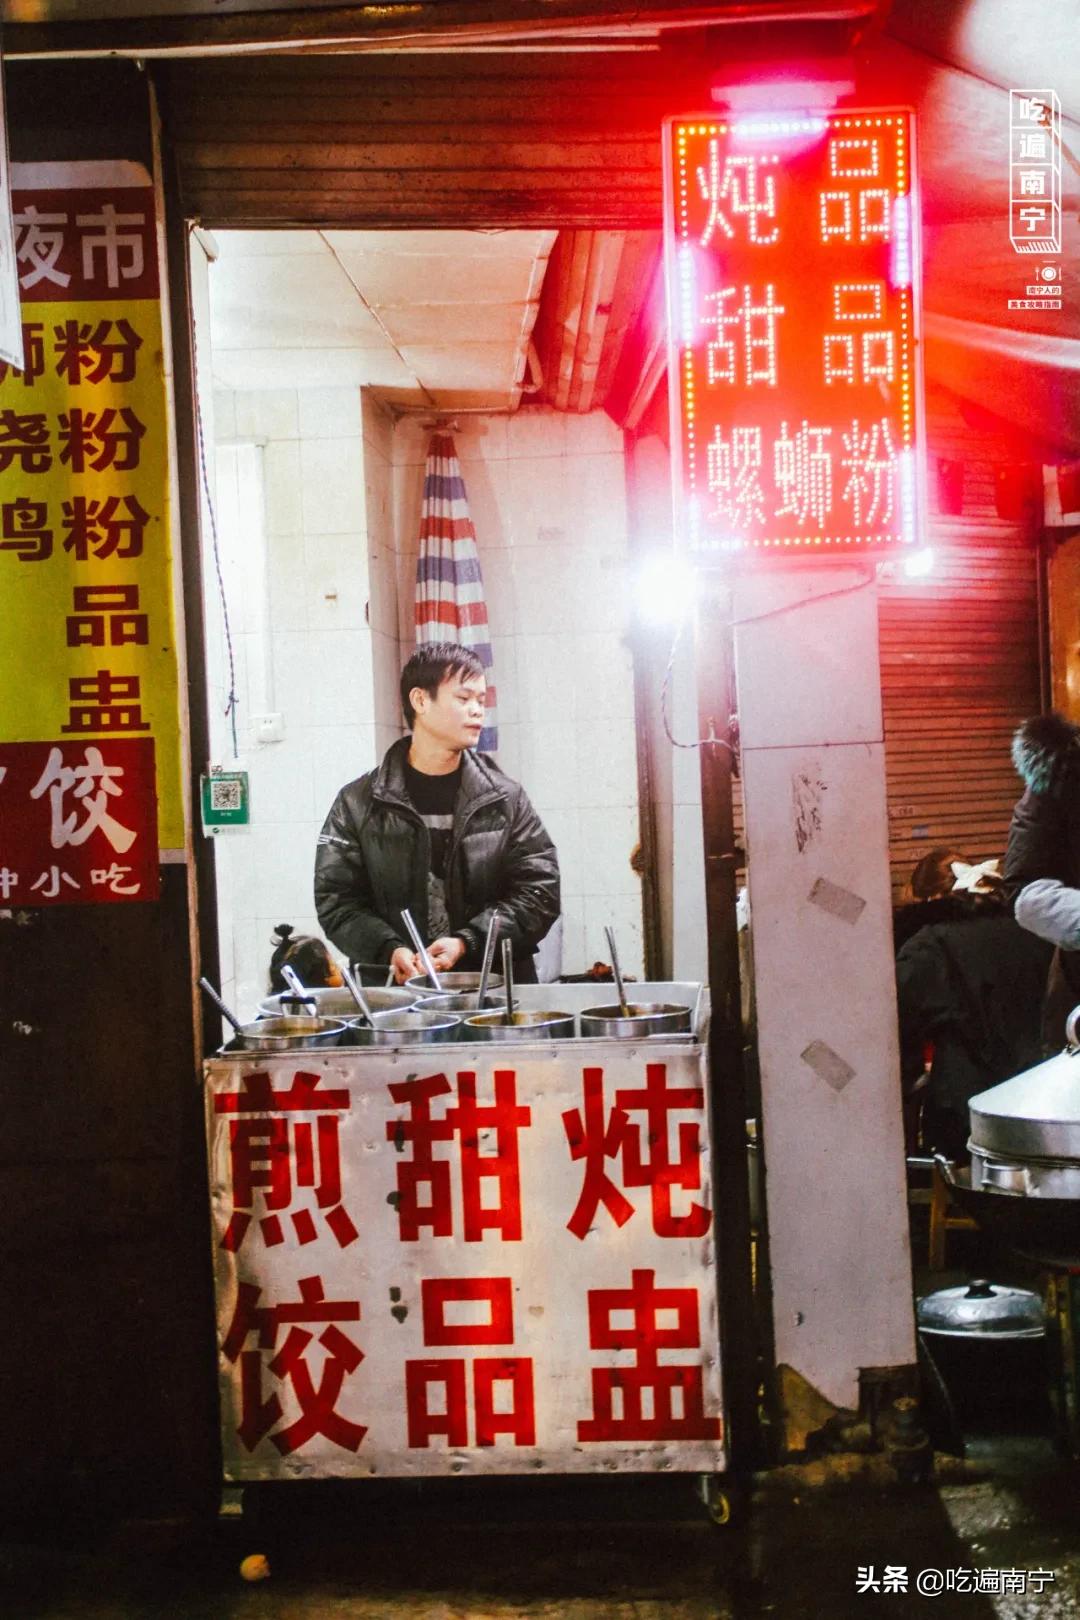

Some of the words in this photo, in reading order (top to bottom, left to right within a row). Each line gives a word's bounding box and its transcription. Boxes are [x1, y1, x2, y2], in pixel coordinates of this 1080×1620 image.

[13, 203, 146, 290] 夜市
[66, 584, 149, 647] 品
[61, 670, 151, 733] 盅
